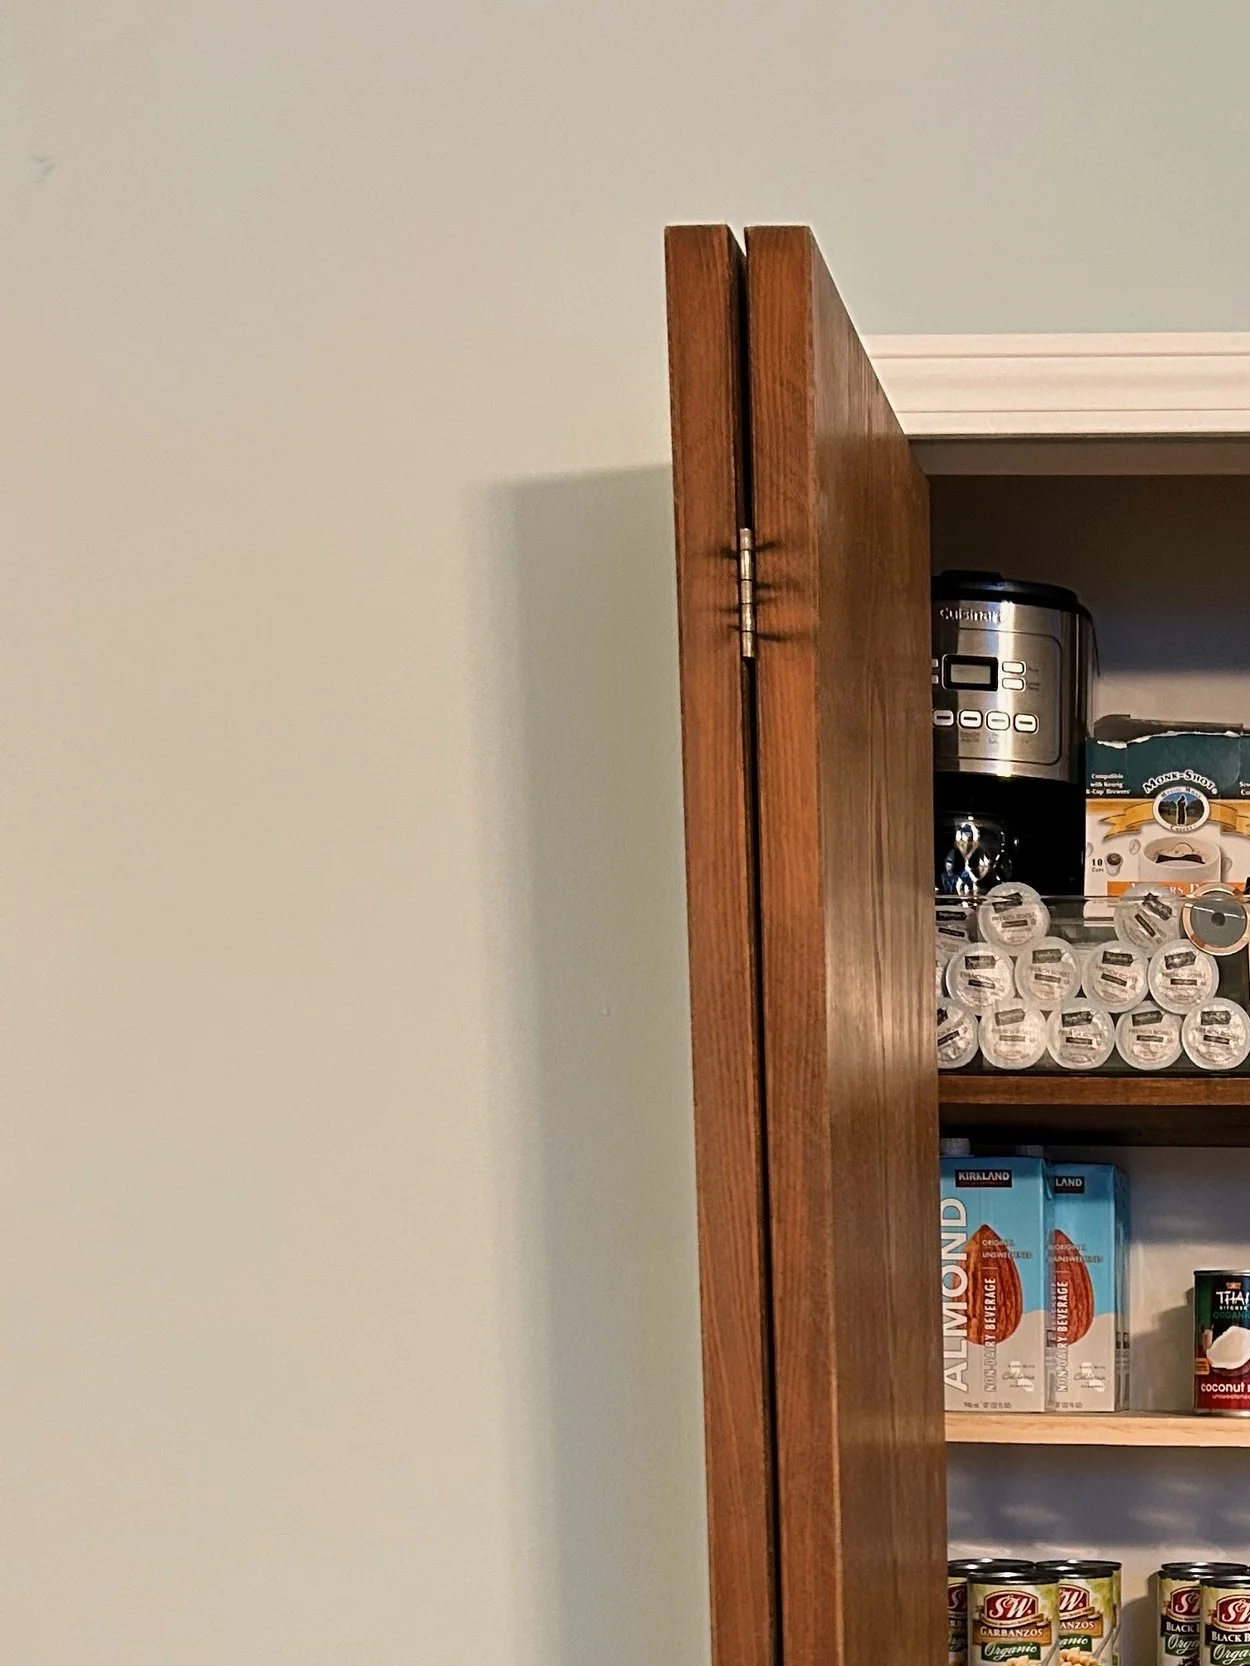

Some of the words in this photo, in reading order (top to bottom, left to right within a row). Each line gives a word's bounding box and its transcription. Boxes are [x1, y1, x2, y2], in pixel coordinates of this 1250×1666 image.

[958, 1172, 1010, 1181] KIRKLAND
[1055, 1178, 1082, 1187] LAND
[941, 1198, 968, 1392] ALMOND
[1216, 1291, 1249, 1306] THAI
[984, 1278, 996, 1330] BEVERAGE
[1056, 1281, 1069, 1333] BEVERAGE
[1200, 1383, 1244, 1393] coconut
[1060, 1621, 1094, 1630] ANZOS
[980, 1626, 1043, 1638] GARBANZOS
[1211, 1631, 1242, 1643] BLACK
[984, 1642, 1038, 1660] Organic
